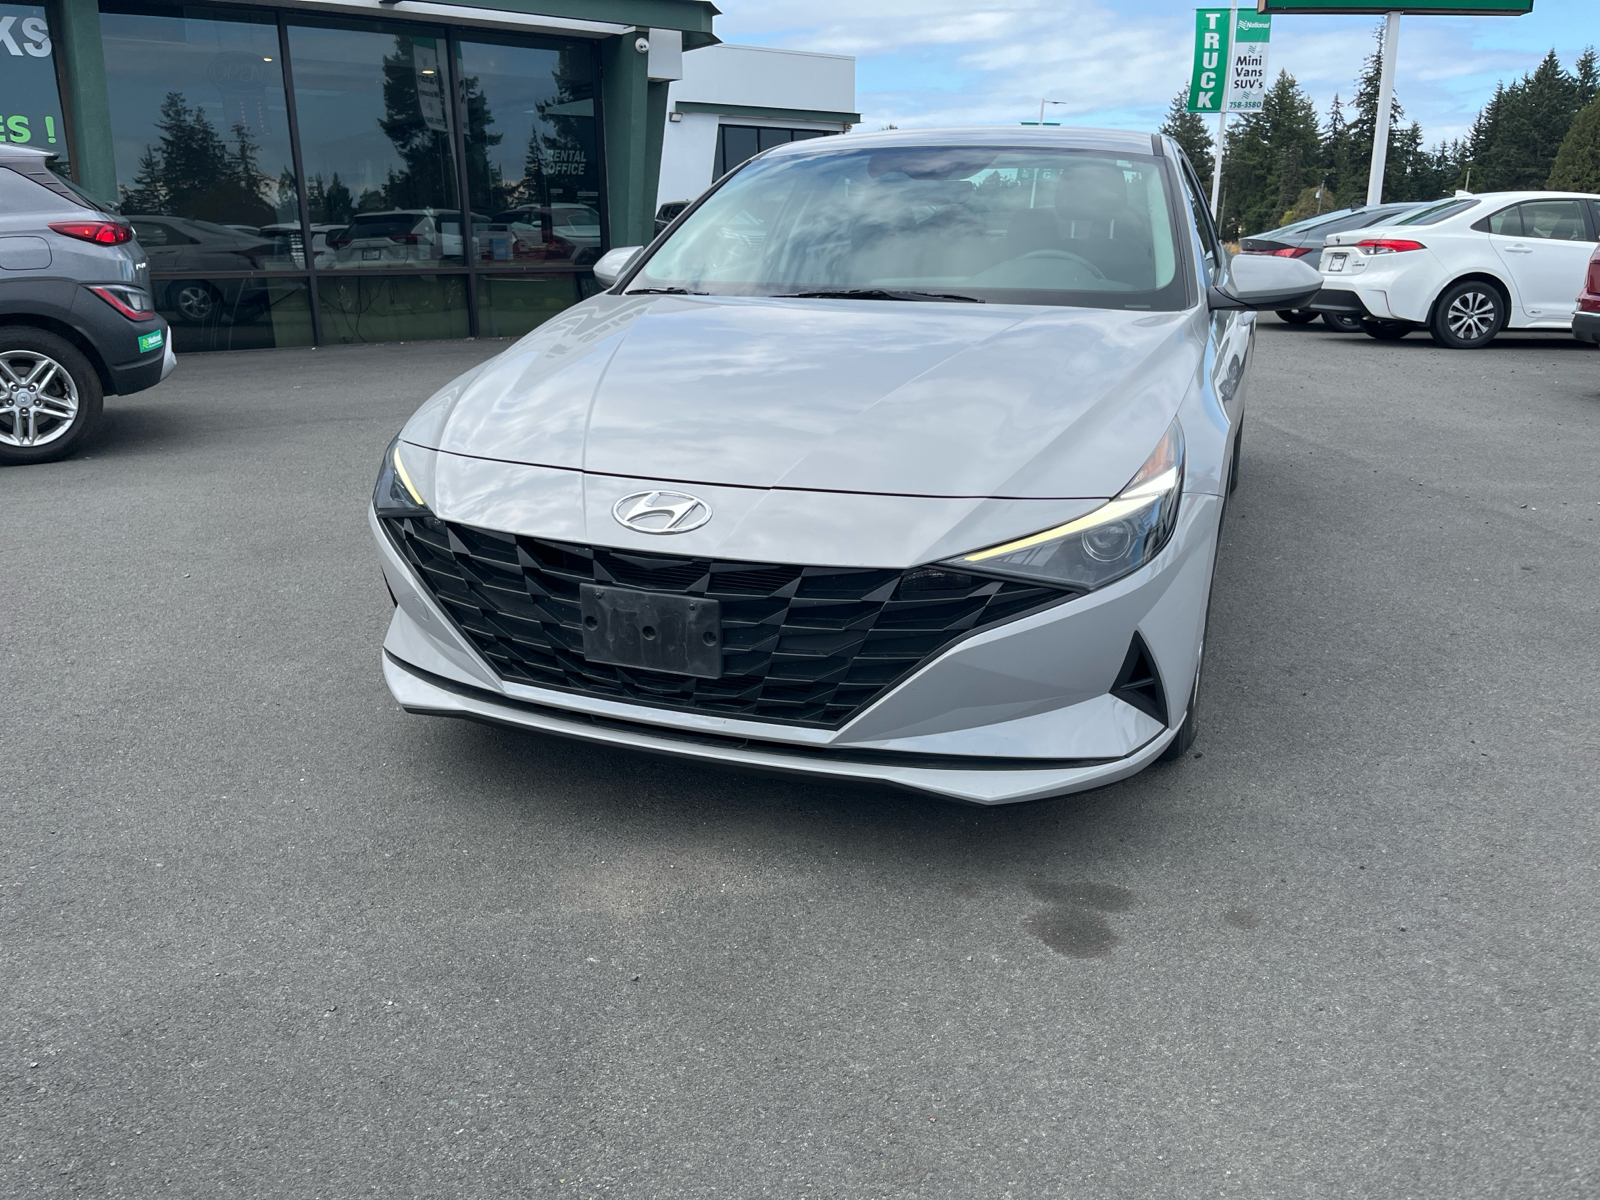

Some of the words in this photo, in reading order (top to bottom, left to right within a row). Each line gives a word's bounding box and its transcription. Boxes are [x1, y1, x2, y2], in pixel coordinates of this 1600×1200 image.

[1197, 13, 1221, 109] TRUCK
[1236, 55, 1263, 66] Mini
[1235, 67, 1263, 78] Vans
[1233, 79, 1263, 89] SUV's
[0, 115, 31, 143] S
[547, 150, 587, 162] RENTAL
[548, 162, 586, 175] OFFICE
